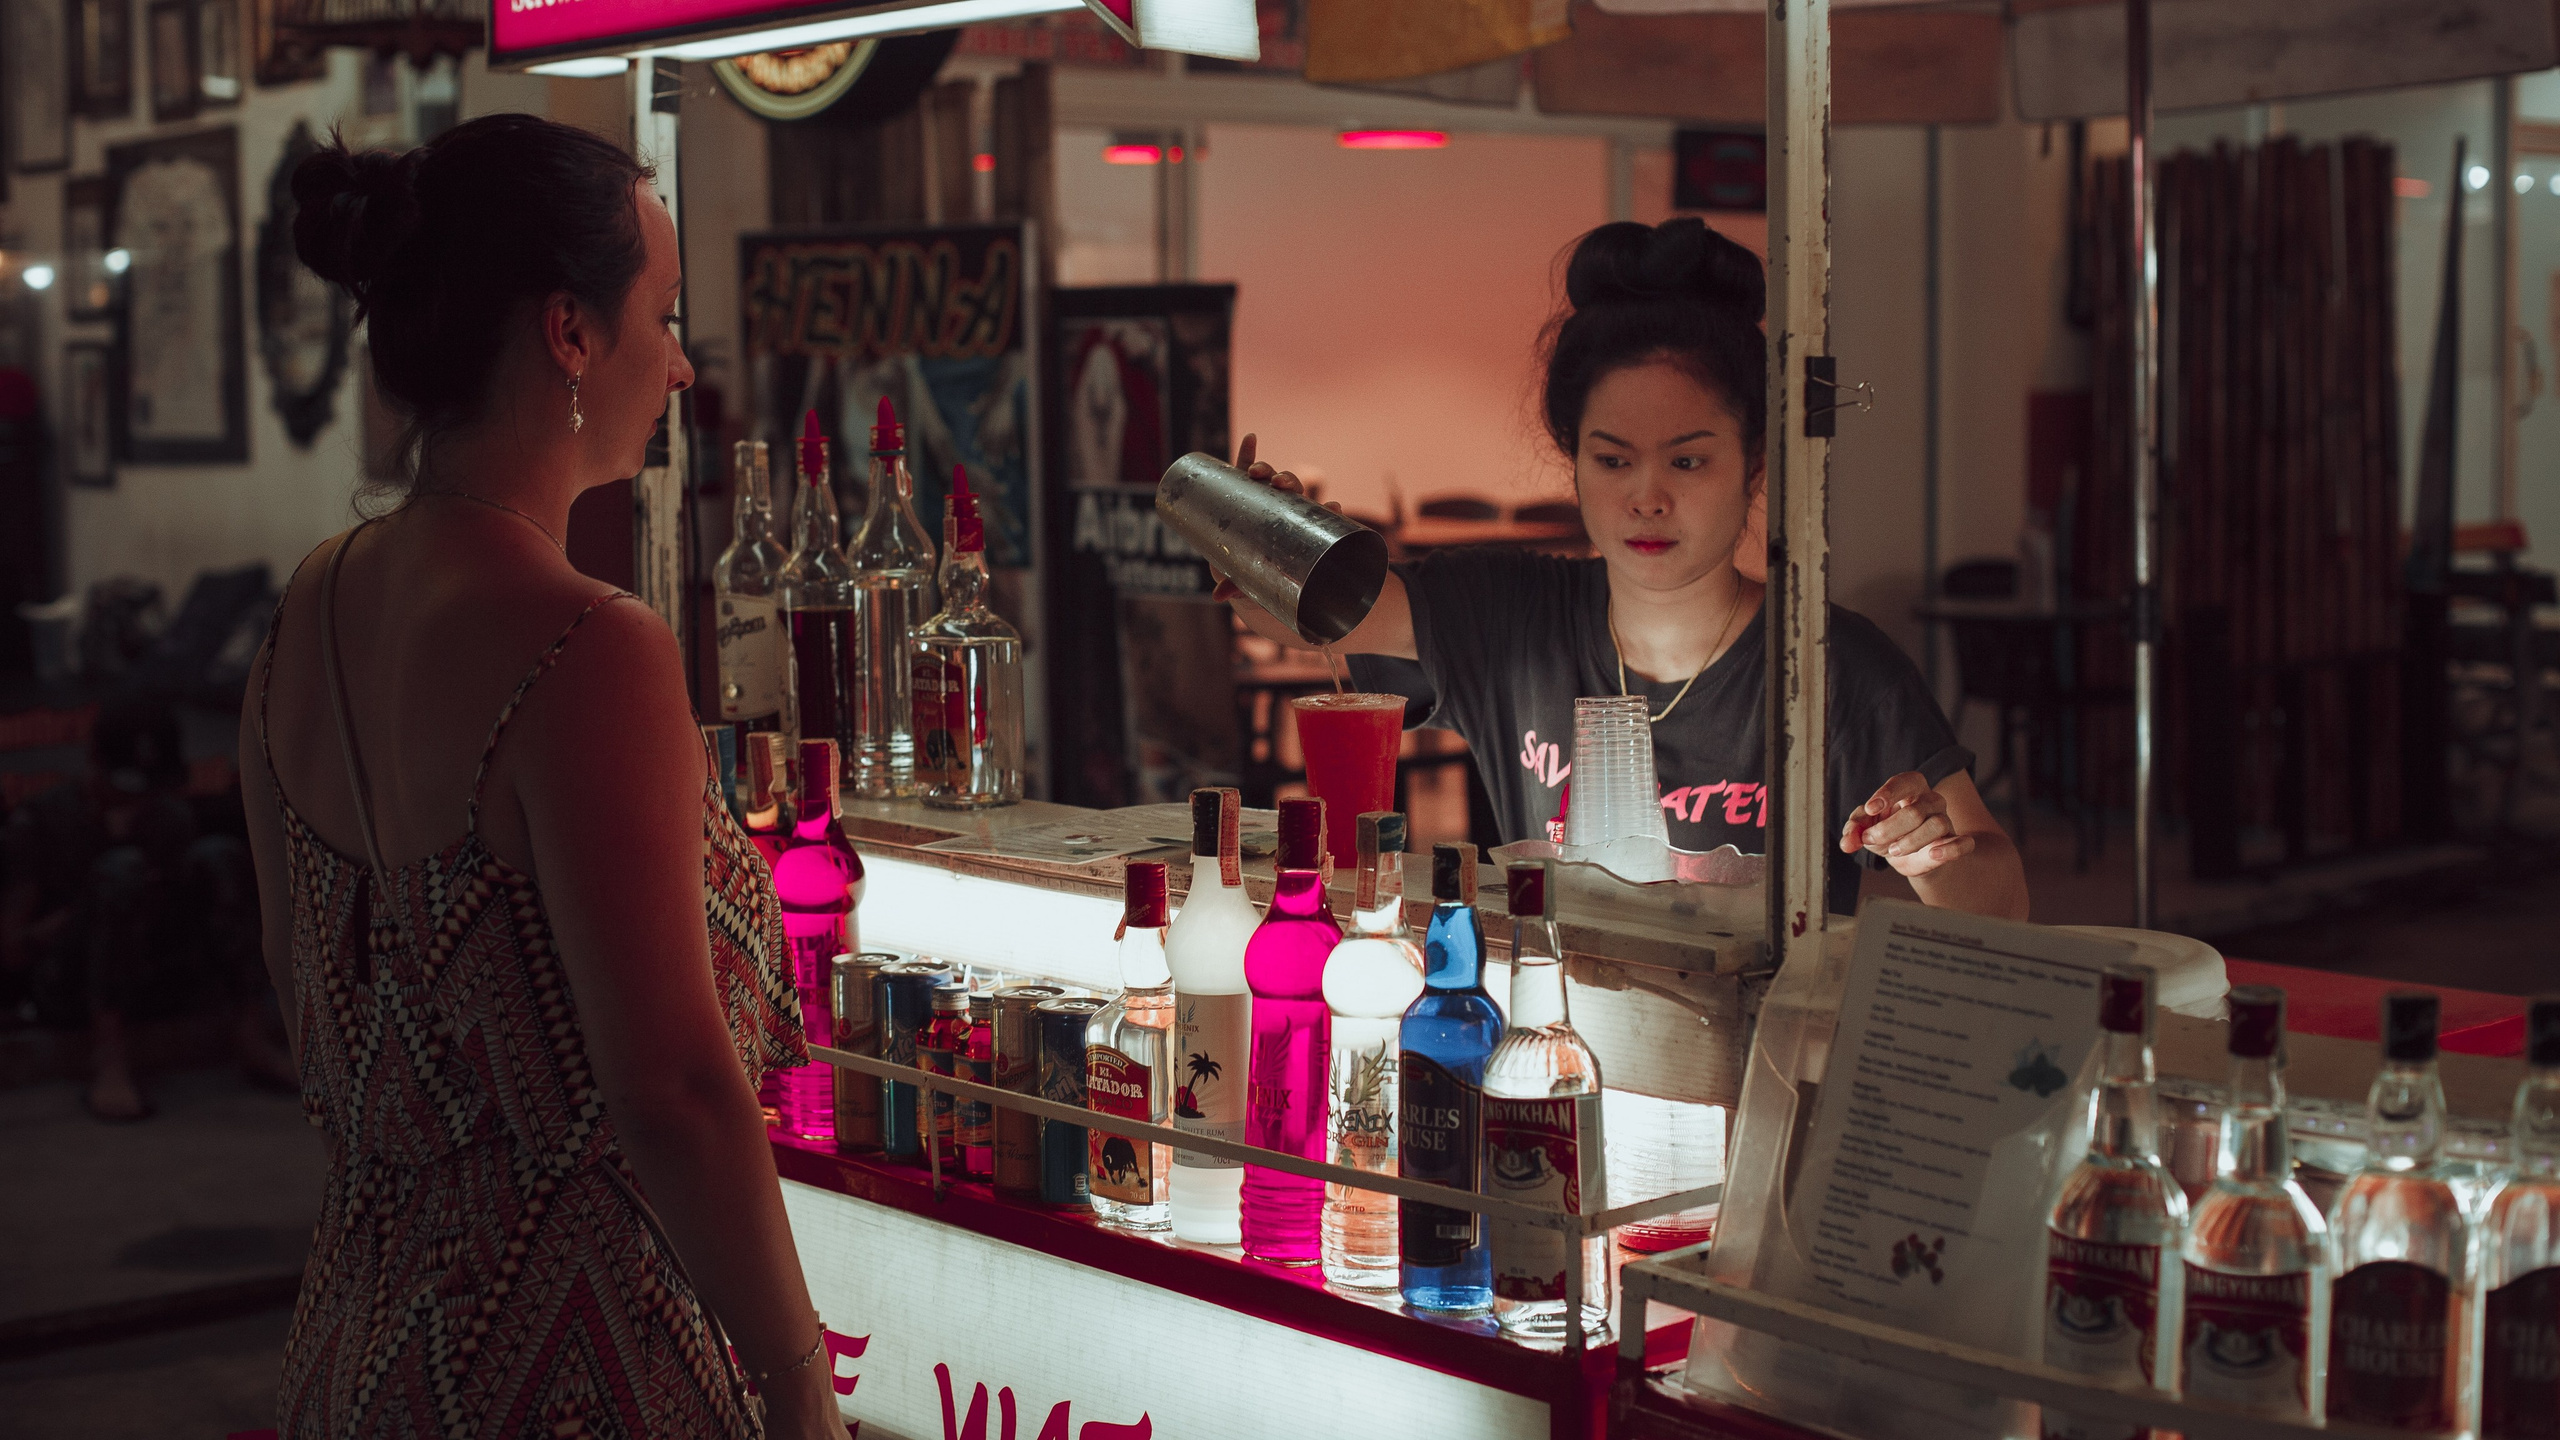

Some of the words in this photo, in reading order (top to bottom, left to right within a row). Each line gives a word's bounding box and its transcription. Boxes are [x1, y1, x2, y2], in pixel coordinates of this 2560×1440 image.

[746, 240, 1018, 358] HENNA
[1658, 779, 1768, 828] ATE
[1401, 1101, 1460, 1130] ARLES
[1486, 1098, 1572, 1135] NGYIKHAN
[1206, 1129, 1225, 1138] RUM
[1351, 1134, 1390, 1148] GIN
[1401, 1122, 1447, 1151] OUSE
[1130, 1191, 1139, 1200] 70
